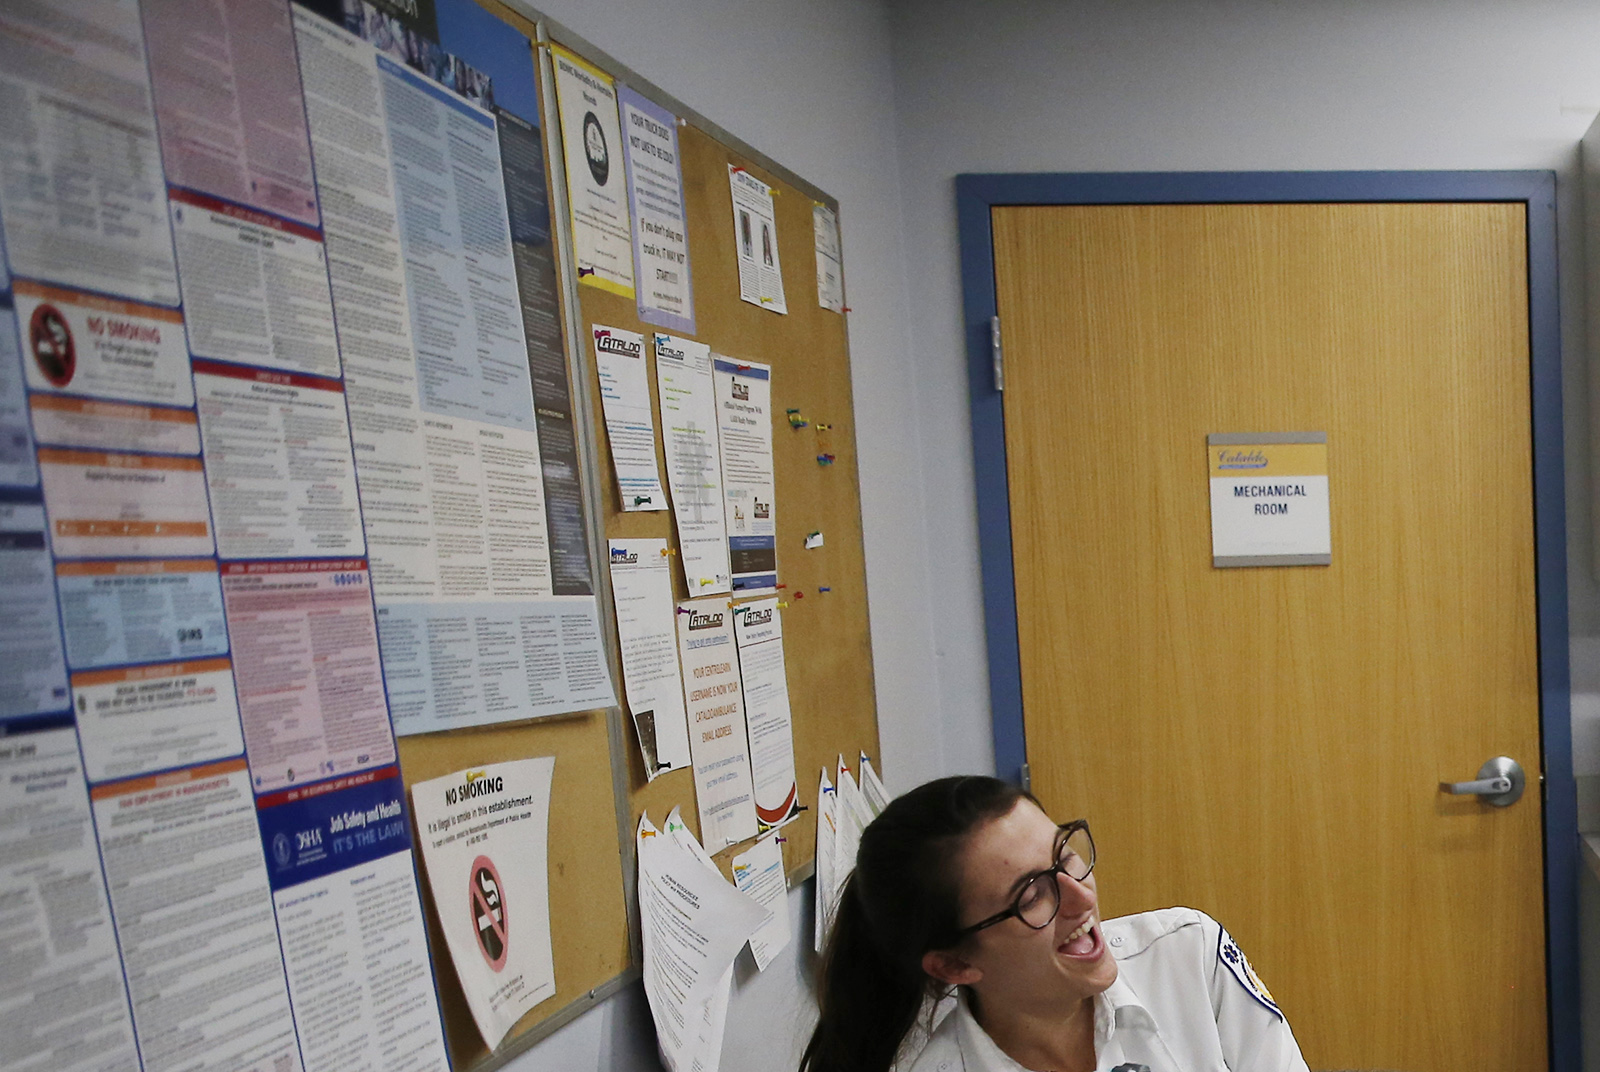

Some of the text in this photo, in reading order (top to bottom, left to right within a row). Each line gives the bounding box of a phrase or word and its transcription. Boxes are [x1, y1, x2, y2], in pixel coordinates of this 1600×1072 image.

[1234, 485, 1307, 497] MECHANICAL
[1254, 503, 1288, 515] ROOM
[689, 610, 724, 630] CATALDO
[744, 607, 772, 627] CATALDO
[445, 776, 504, 806] NO SMOKING
[330, 799, 401, 834] Job Safety and Health
[456, 810, 471, 823] smoke
[472, 809, 478, 818] in
[477, 805, 488, 817] this
[488, 795, 533, 814] establishment.
[333, 835, 354, 854] IT'S
[354, 828, 377, 846] THE
